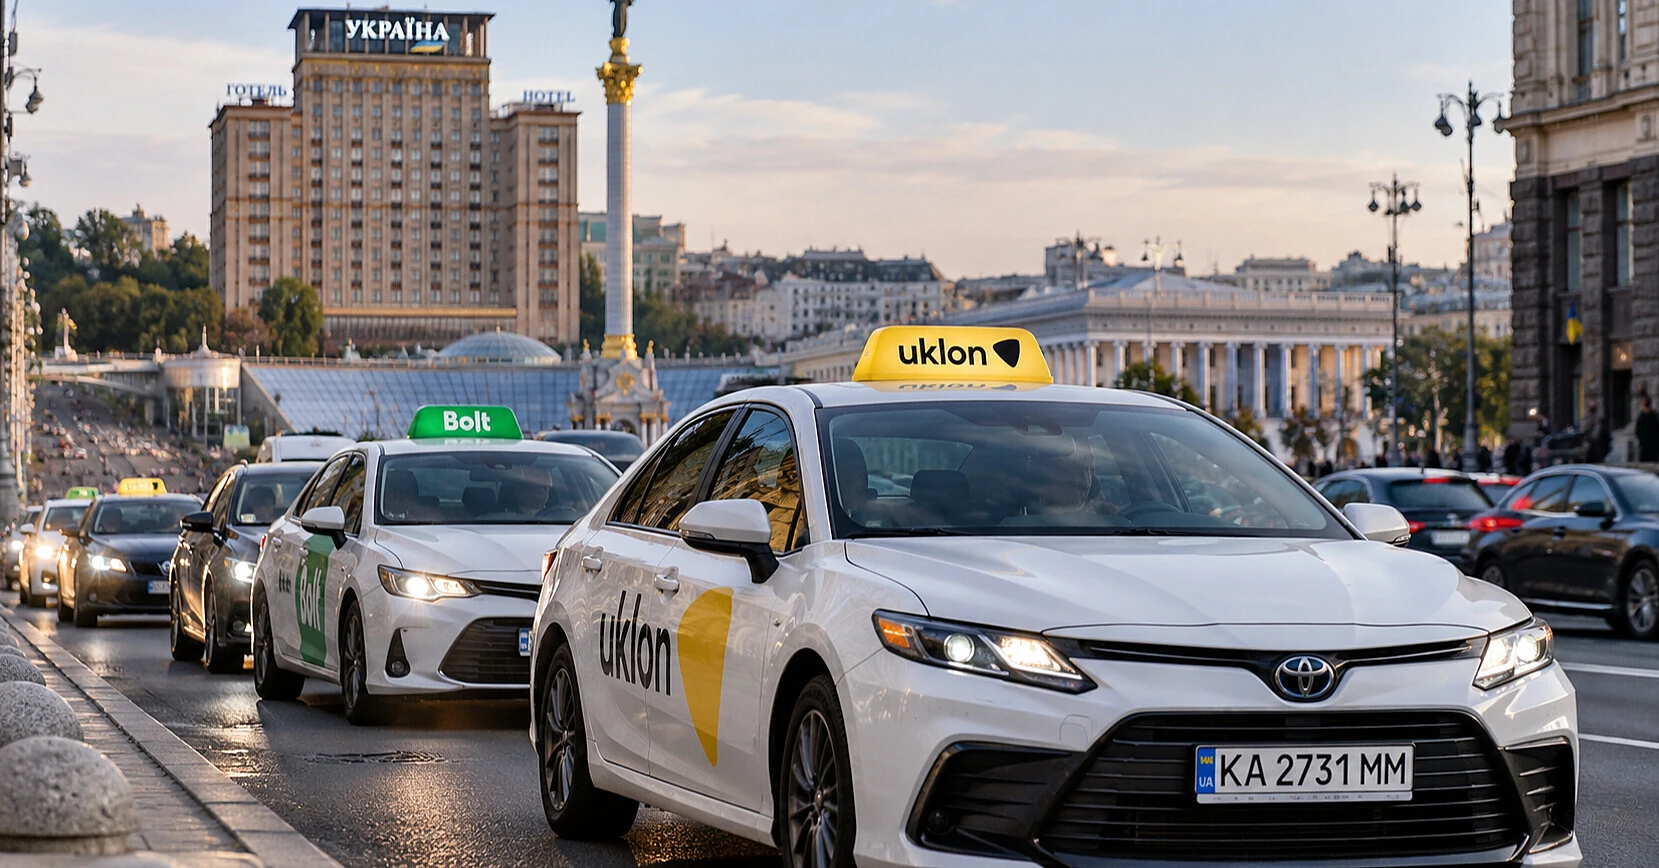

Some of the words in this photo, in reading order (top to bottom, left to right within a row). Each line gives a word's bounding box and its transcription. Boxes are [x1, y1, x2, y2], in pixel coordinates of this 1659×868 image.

[345, 16, 450, 40] УКРАЇНА
[226, 84, 287, 98] ГОТЕЛЬ
[523, 90, 576, 103] HOTEL
[898, 338, 987, 365] uklon
[443, 410, 491, 433] Bolt
[300, 564, 322, 632] Bolt
[600, 590, 671, 696] uklon
[1221, 754, 1267, 787] KA
[1276, 753, 1348, 786] 2731
[1360, 752, 1406, 785] MM
[1199, 777, 1213, 787] UA
